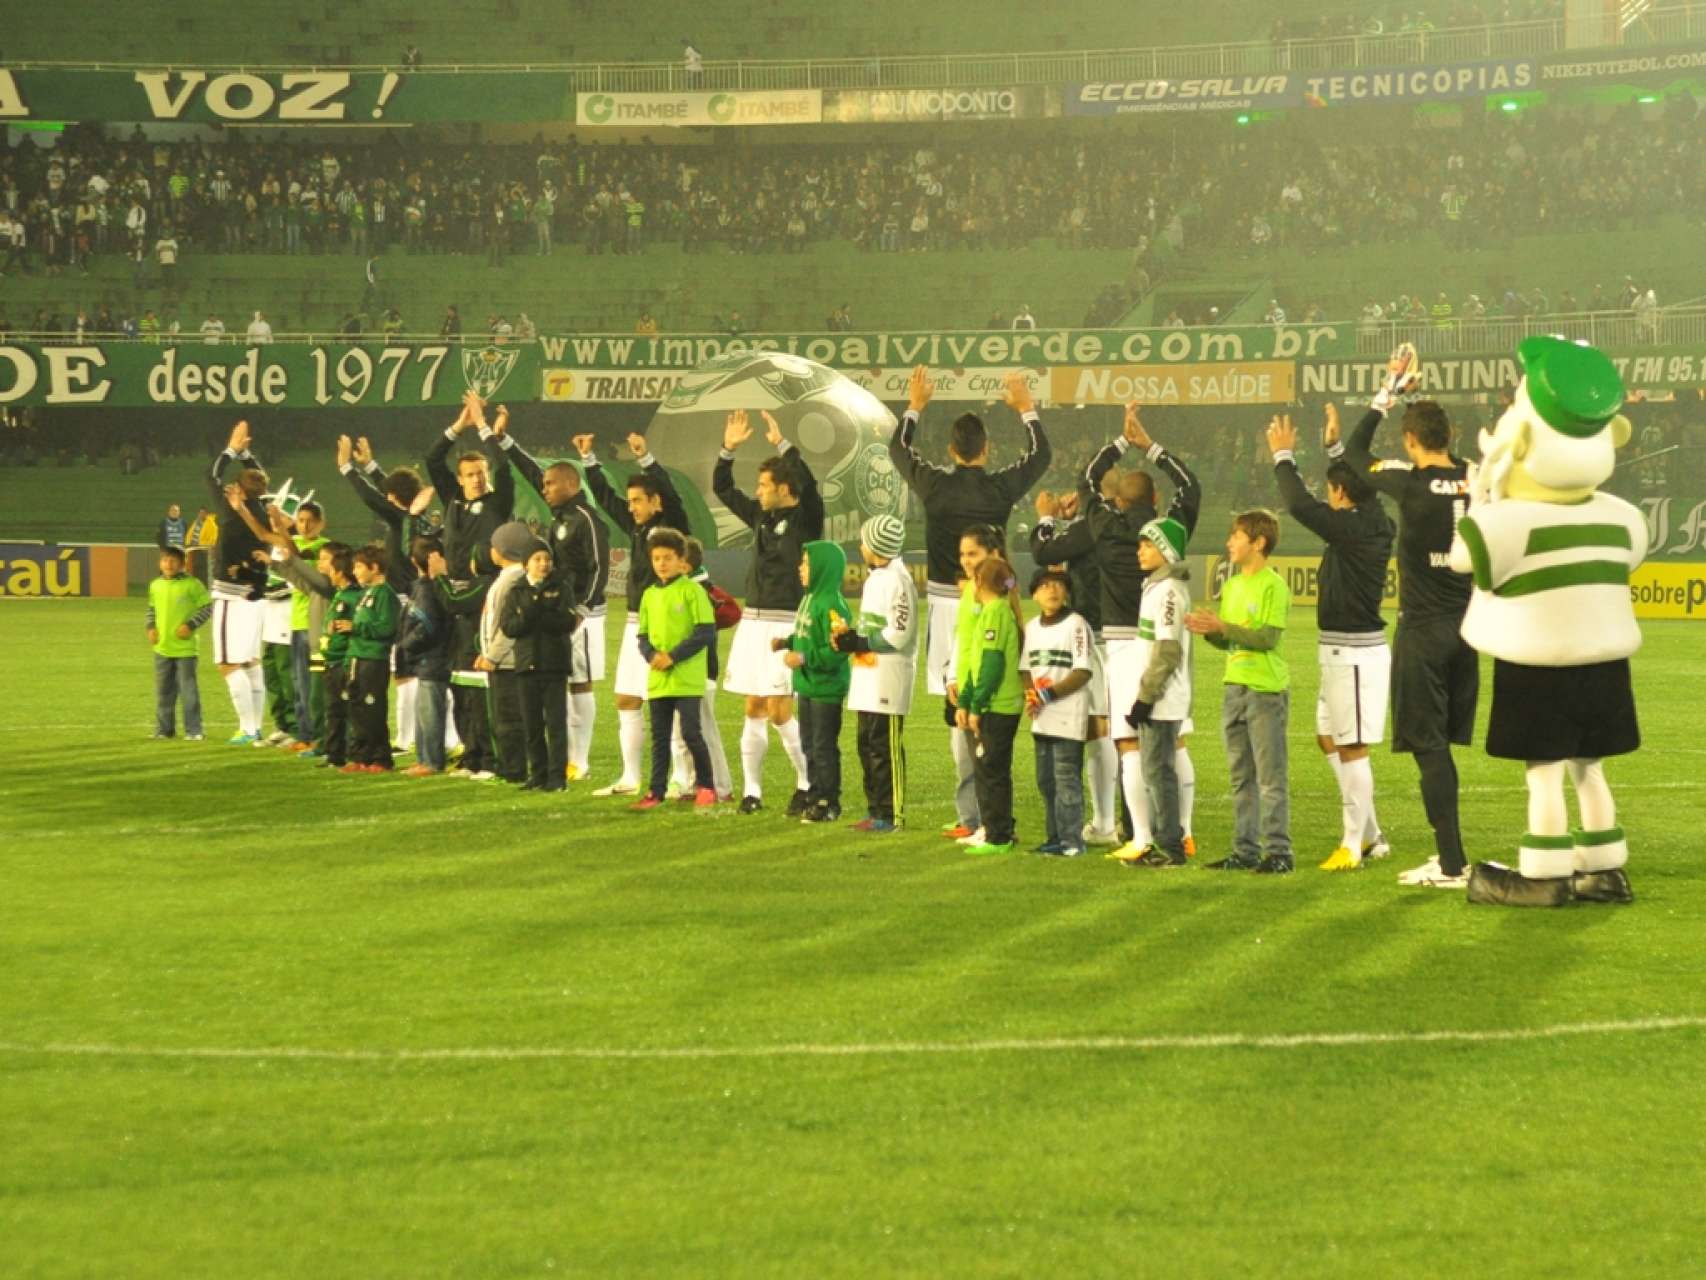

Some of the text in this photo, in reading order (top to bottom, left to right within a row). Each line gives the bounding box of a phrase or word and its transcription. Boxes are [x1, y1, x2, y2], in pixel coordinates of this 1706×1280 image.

[135, 72, 350, 118] VOZ
[616, 100, 688, 119] ITAMBÉ
[739, 100, 809, 118] ITAMBÉ
[148, 348, 287, 404] desde
[311, 345, 448, 404] 1977
[585, 376, 683, 400] TRANSA
[1076, 368, 1271, 399] NOSSA SAÚDE
[1303, 359, 1519, 393] NUTATINA
[0, 549, 81, 596] aú
